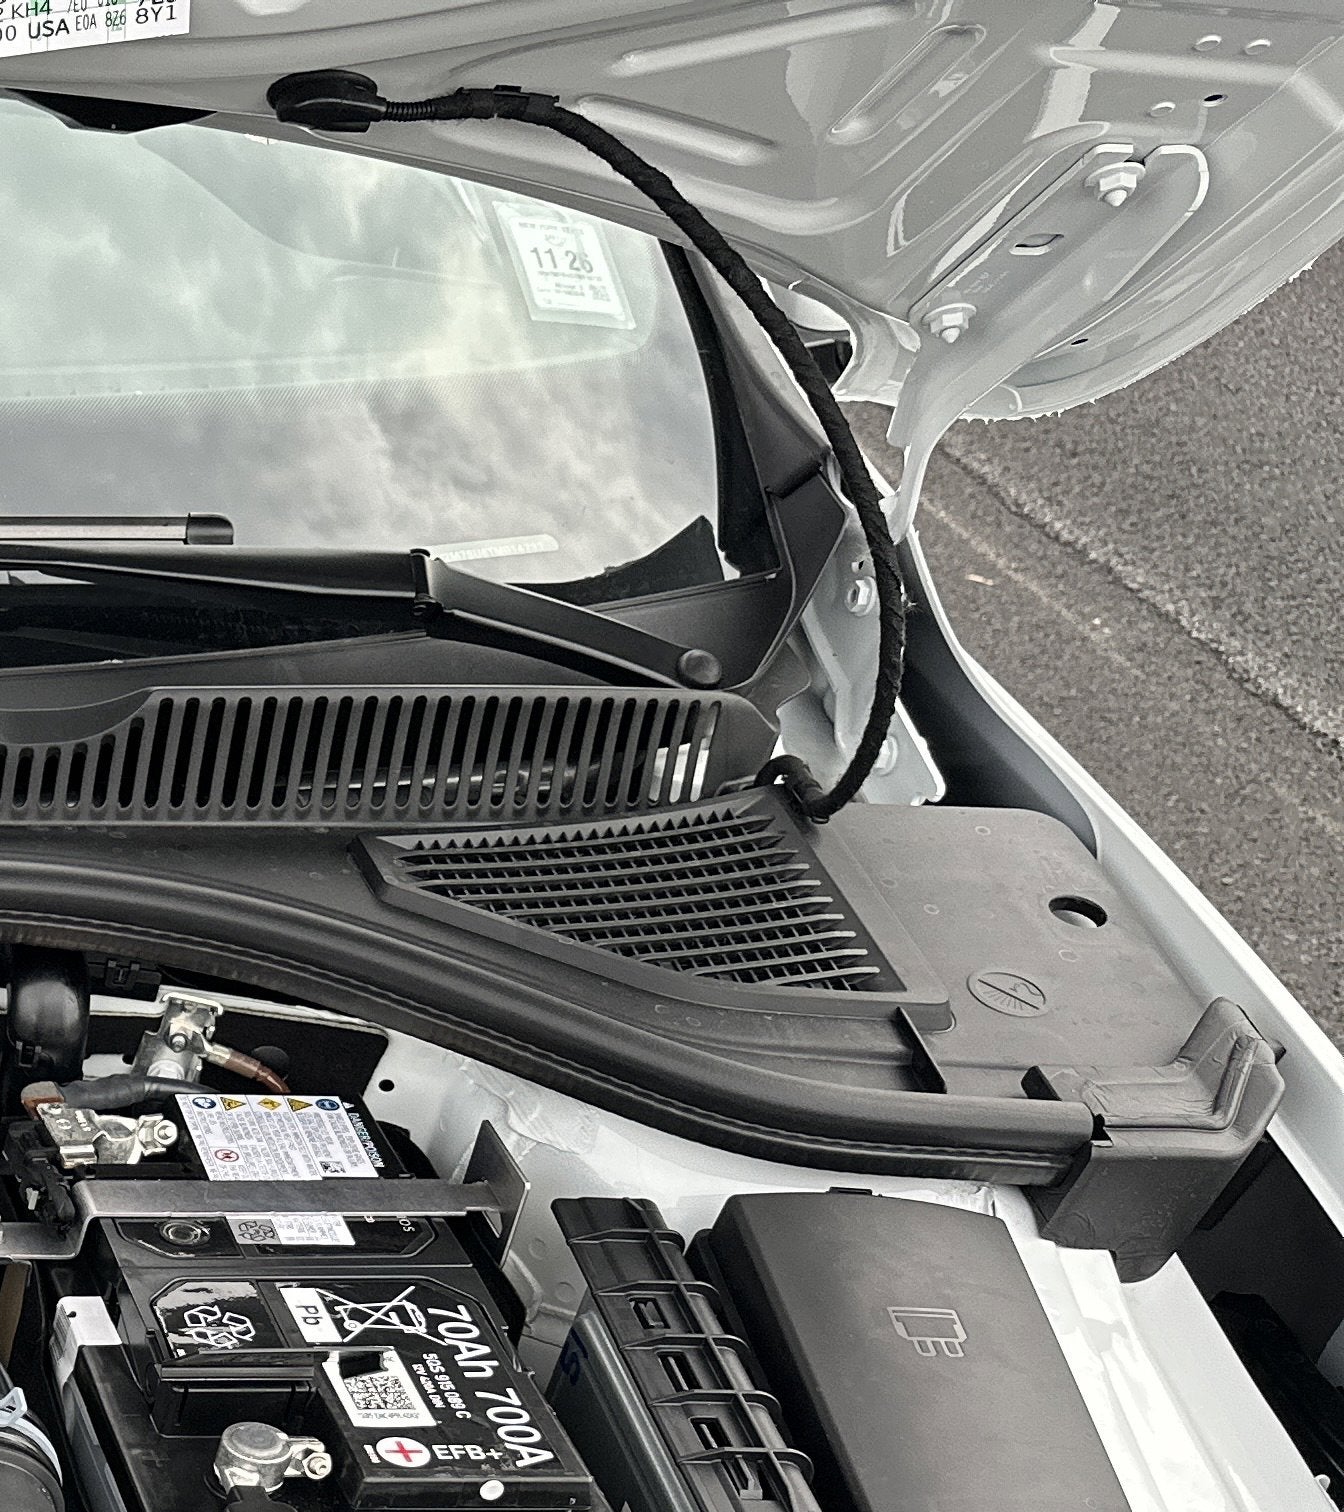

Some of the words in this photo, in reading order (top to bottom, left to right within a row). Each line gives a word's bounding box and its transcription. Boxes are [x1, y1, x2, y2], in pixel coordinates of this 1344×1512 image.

[28, 18, 70, 39] USA
[135, 4, 177, 24] 8Y1
[564, 250, 594, 273] 26
[294, 1304, 320, 1327] Pb
[427, 1304, 500, 1378] 70Ah
[475, 1388, 554, 1468] 700A
[432, 1445, 503, 1460] EFB+
